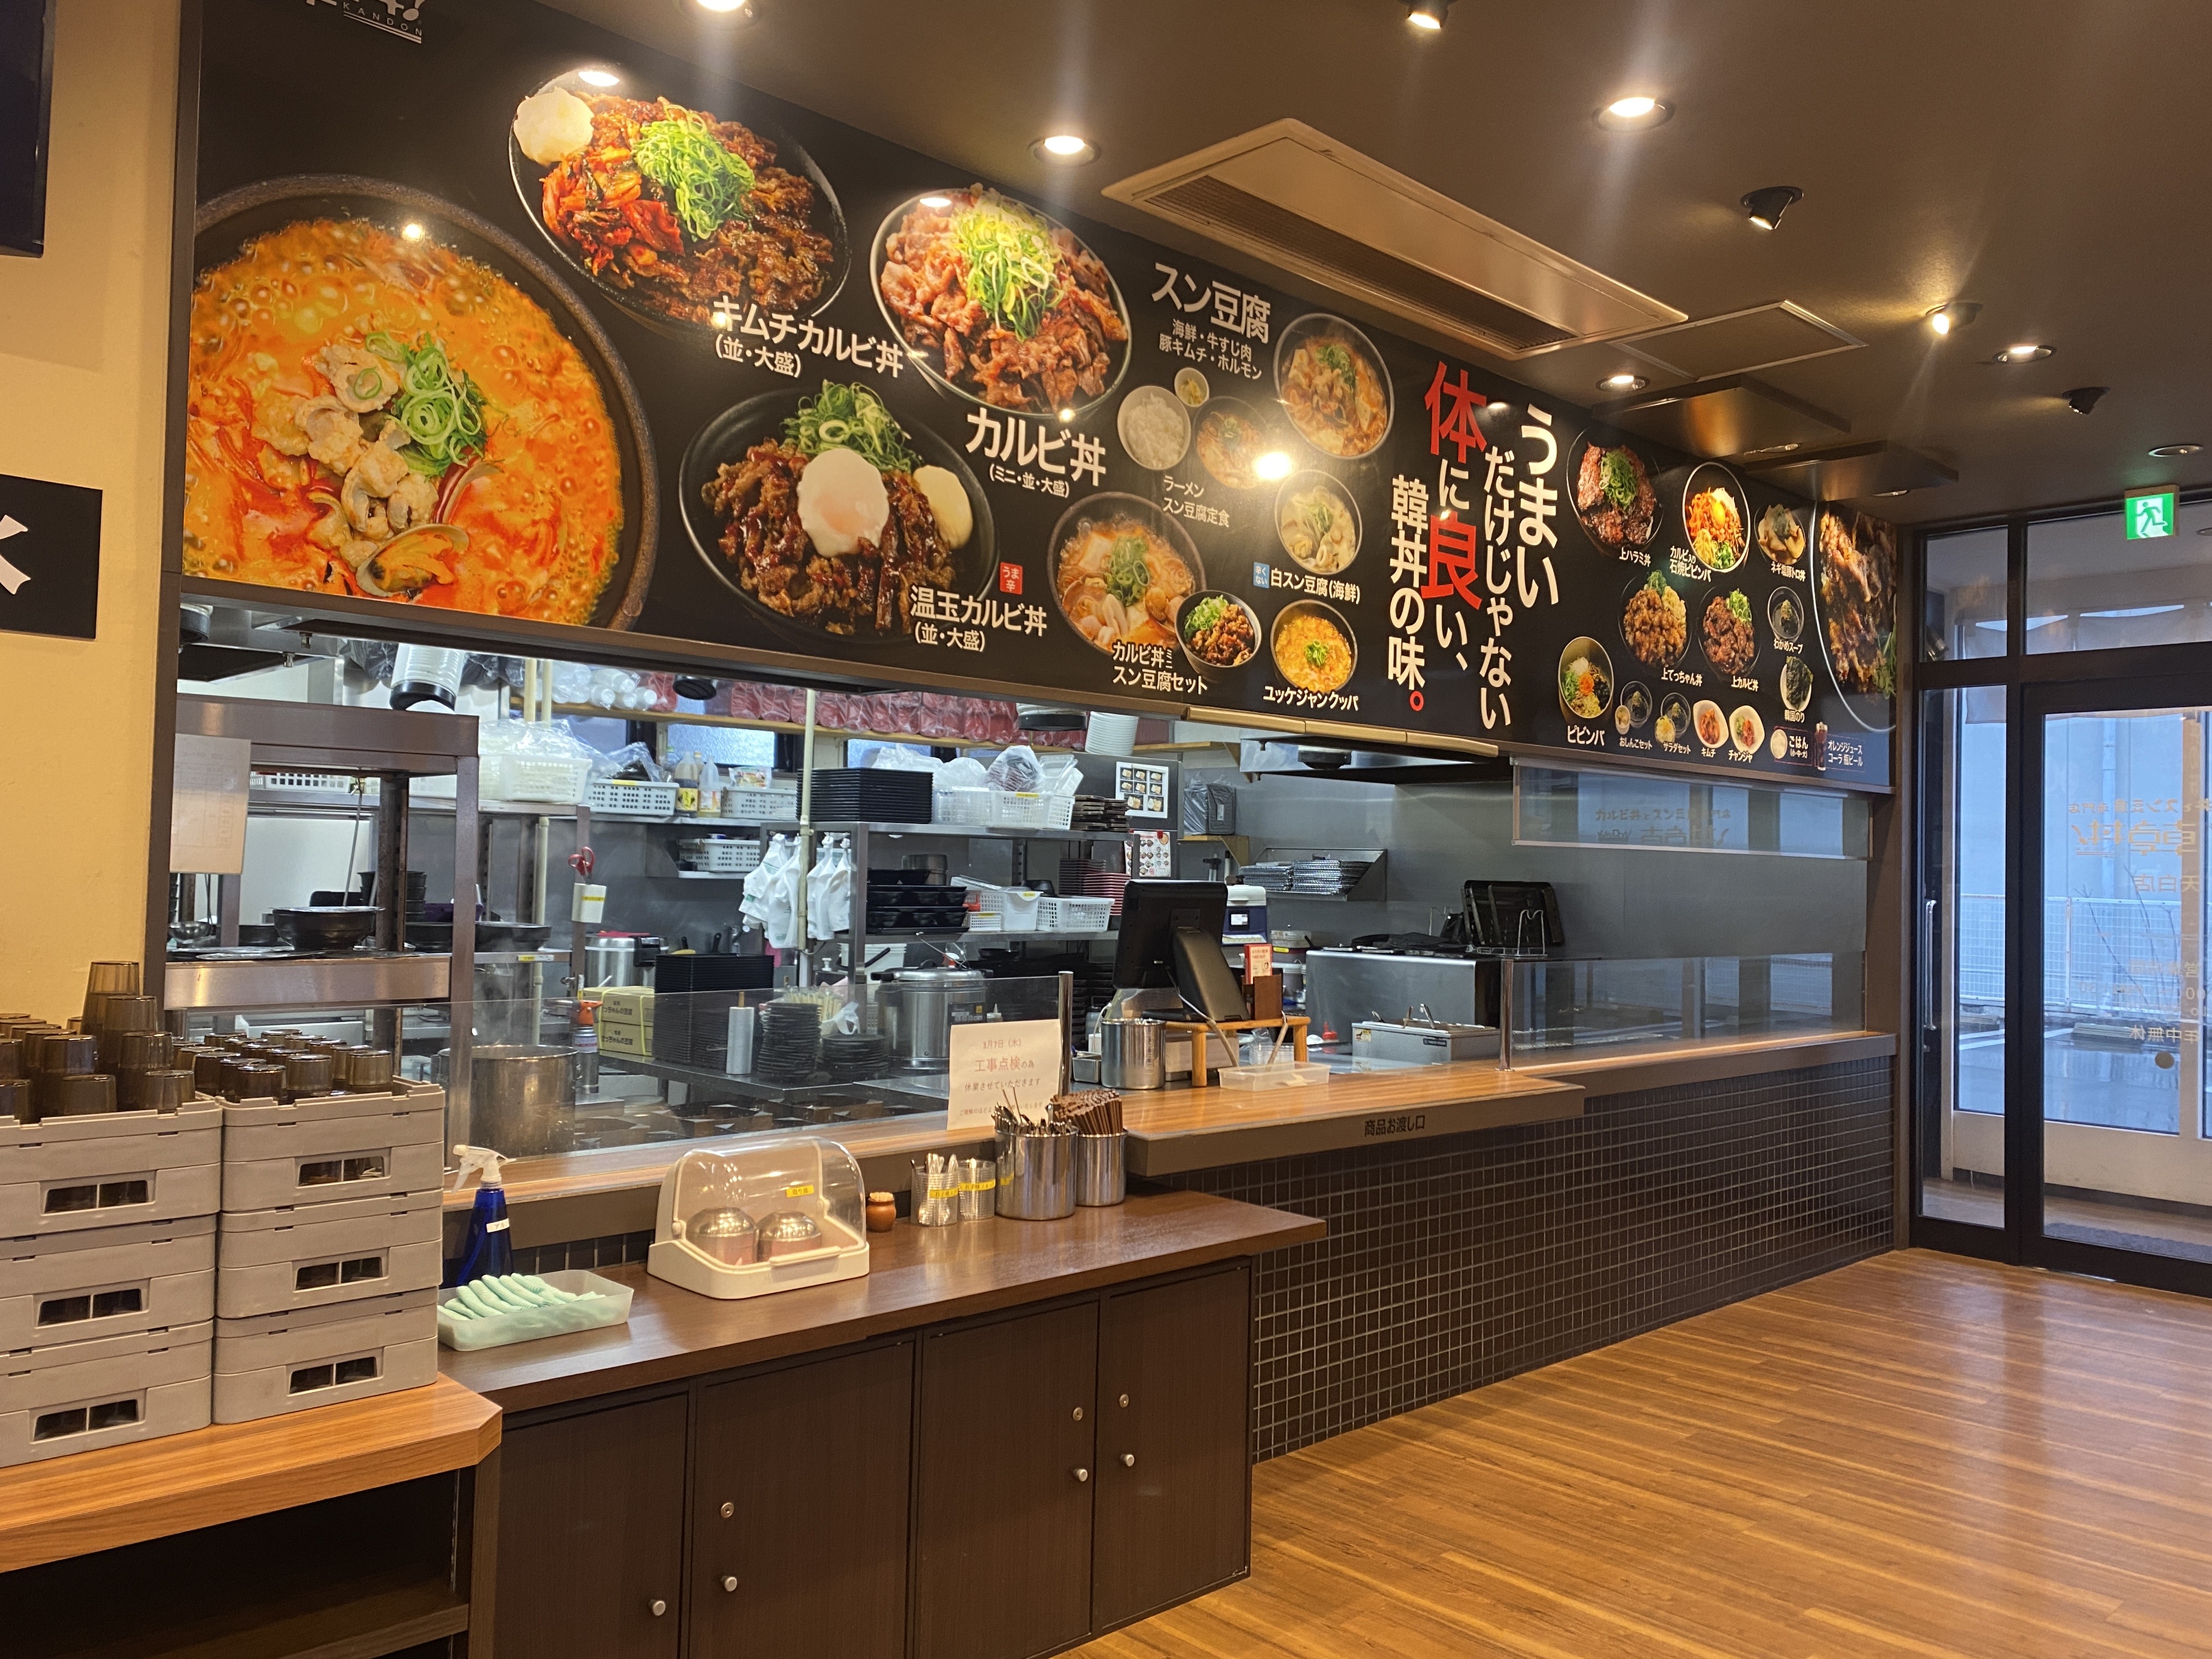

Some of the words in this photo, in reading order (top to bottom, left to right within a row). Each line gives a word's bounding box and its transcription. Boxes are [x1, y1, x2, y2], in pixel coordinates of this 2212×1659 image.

[343, 2, 422, 36] KANDON
[1152, 262, 1271, 344] スン豆腐
[713, 295, 904, 377] キムチカルビ丼
[1172, 318, 1252, 362] 海鮮・牛すじ肉
[715, 333, 802, 379] (並・大盛)
[1158, 332, 1262, 381] 豚キムチ・ホルモン
[965, 407, 1107, 487] カルビ丼
[989, 464, 1070, 499] (ミニ・並・大盛)
[1163, 475, 1205, 499] ラーメン
[1162, 496, 1231, 528] スン豆腐定食
[1420, 360, 1487, 671] 体に良い、
[1516, 403, 1559, 608] うまい
[1619, 546, 1651, 567] 上ハラミ丼
[1271, 568, 1361, 605] 白スン豆腐(海鮮)
[1387, 473, 1429, 712] 韓丼の味。
[1479, 444, 1515, 730] だけじゃない
[910, 584, 1047, 636] 温玉カルビ丼
[915, 621, 985, 652] (並・大盛)
[1773, 639, 1803, 653] わかめスープ
[1113, 641, 1164, 668] カルビ丼
[1113, 665, 1207, 695] スン豆腐セット
[1661, 667, 1703, 687] 上てっちゃん丼
[1731, 675, 1759, 692] 上カルビ丼
[1263, 685, 1359, 711] ユッケジャンクッパ
[1619, 736, 1653, 751] おしんこセット
[1663, 741, 1691, 755] サラダセット
[1701, 747, 1717, 758] キムチ
[1728, 750, 1753, 763] チャンジャ
[974, 1056, 1035, 1073] 工事点検の為
[1364, 1115, 1426, 1137] 商品お渡し口
